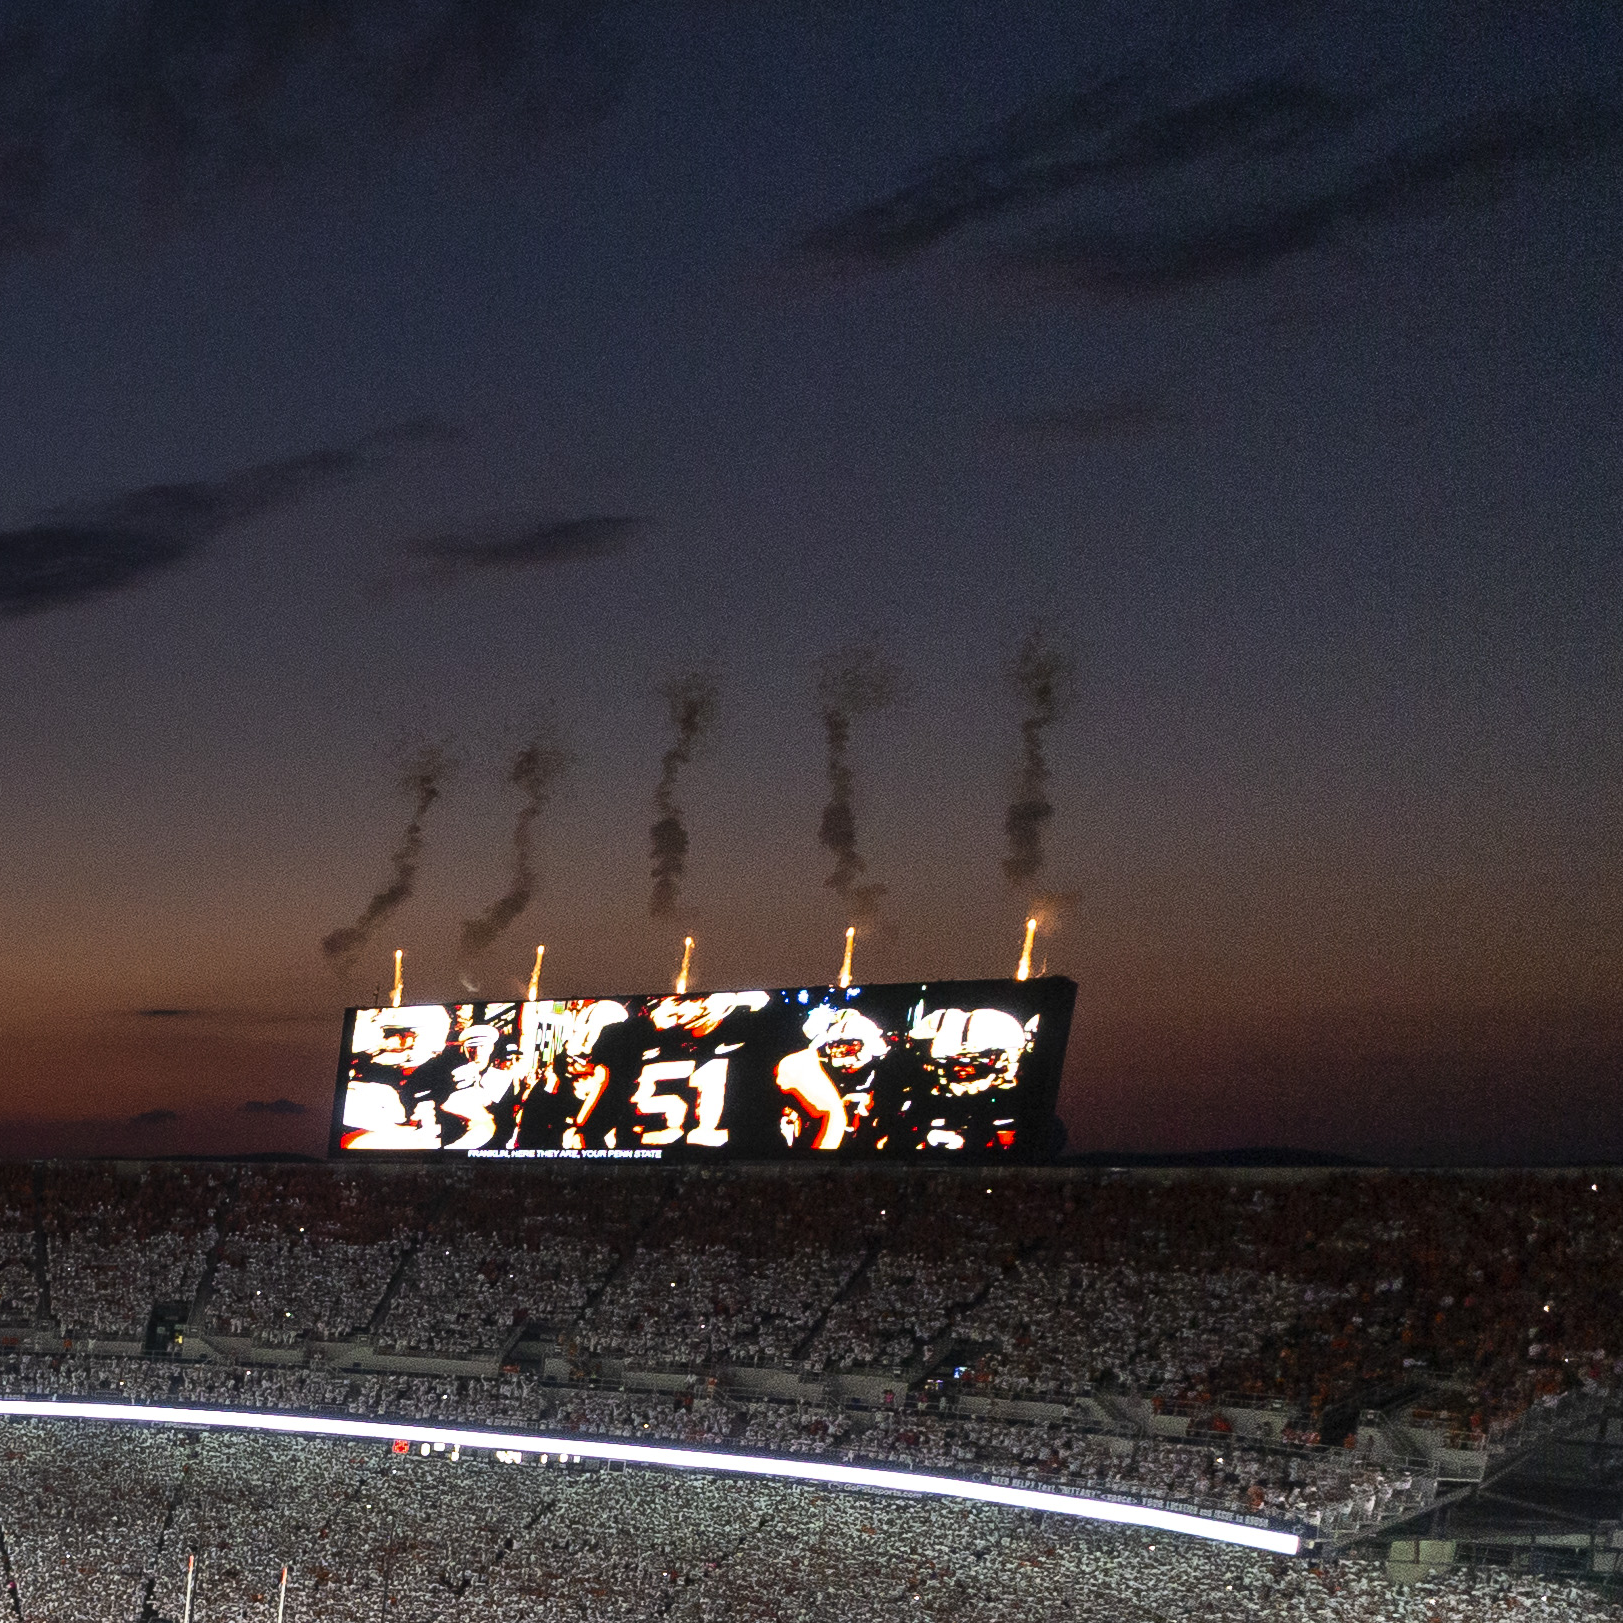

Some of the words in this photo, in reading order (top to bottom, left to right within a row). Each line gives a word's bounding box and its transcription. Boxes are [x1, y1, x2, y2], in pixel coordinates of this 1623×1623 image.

[636, 1059, 729, 1147] 51
[537, 1150, 559, 1158] THEY
[581, 1150, 607, 1158] YOUR
[634, 1150, 662, 1158] STATE
[844, 1483, 922, 1499] GoPSUsports.com
